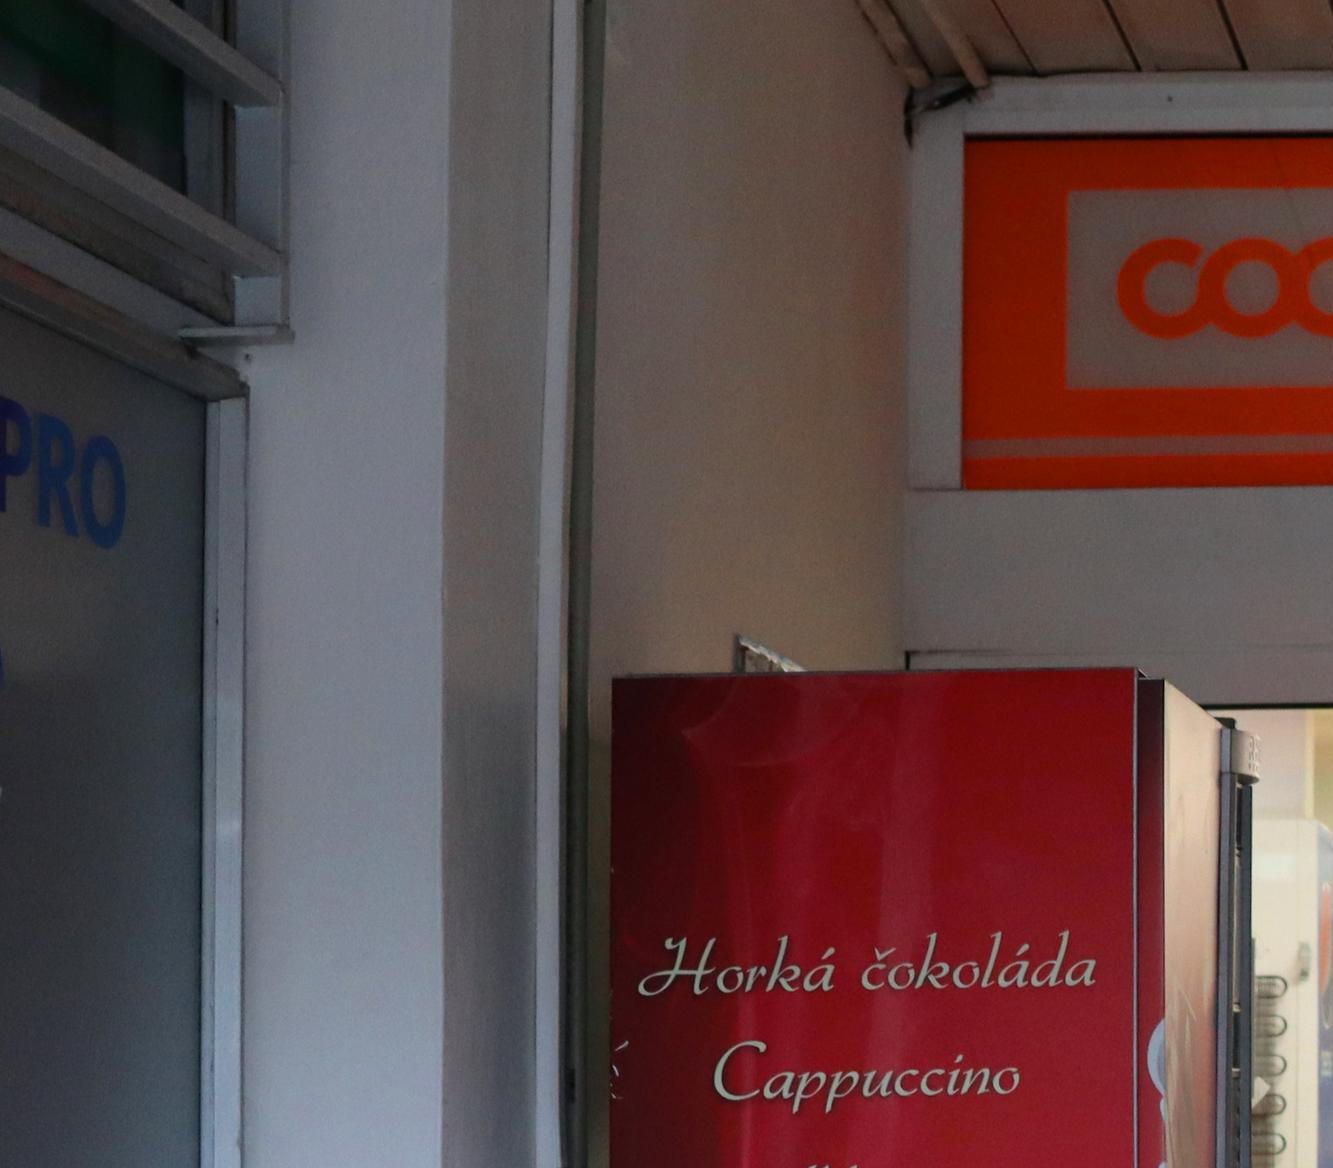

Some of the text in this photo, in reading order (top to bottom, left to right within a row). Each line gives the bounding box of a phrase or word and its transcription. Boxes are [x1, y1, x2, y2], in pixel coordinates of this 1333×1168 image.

[637, 931, 1097, 997] Horká čokoláda
[713, 1041, 1021, 1114] Cappuccino
